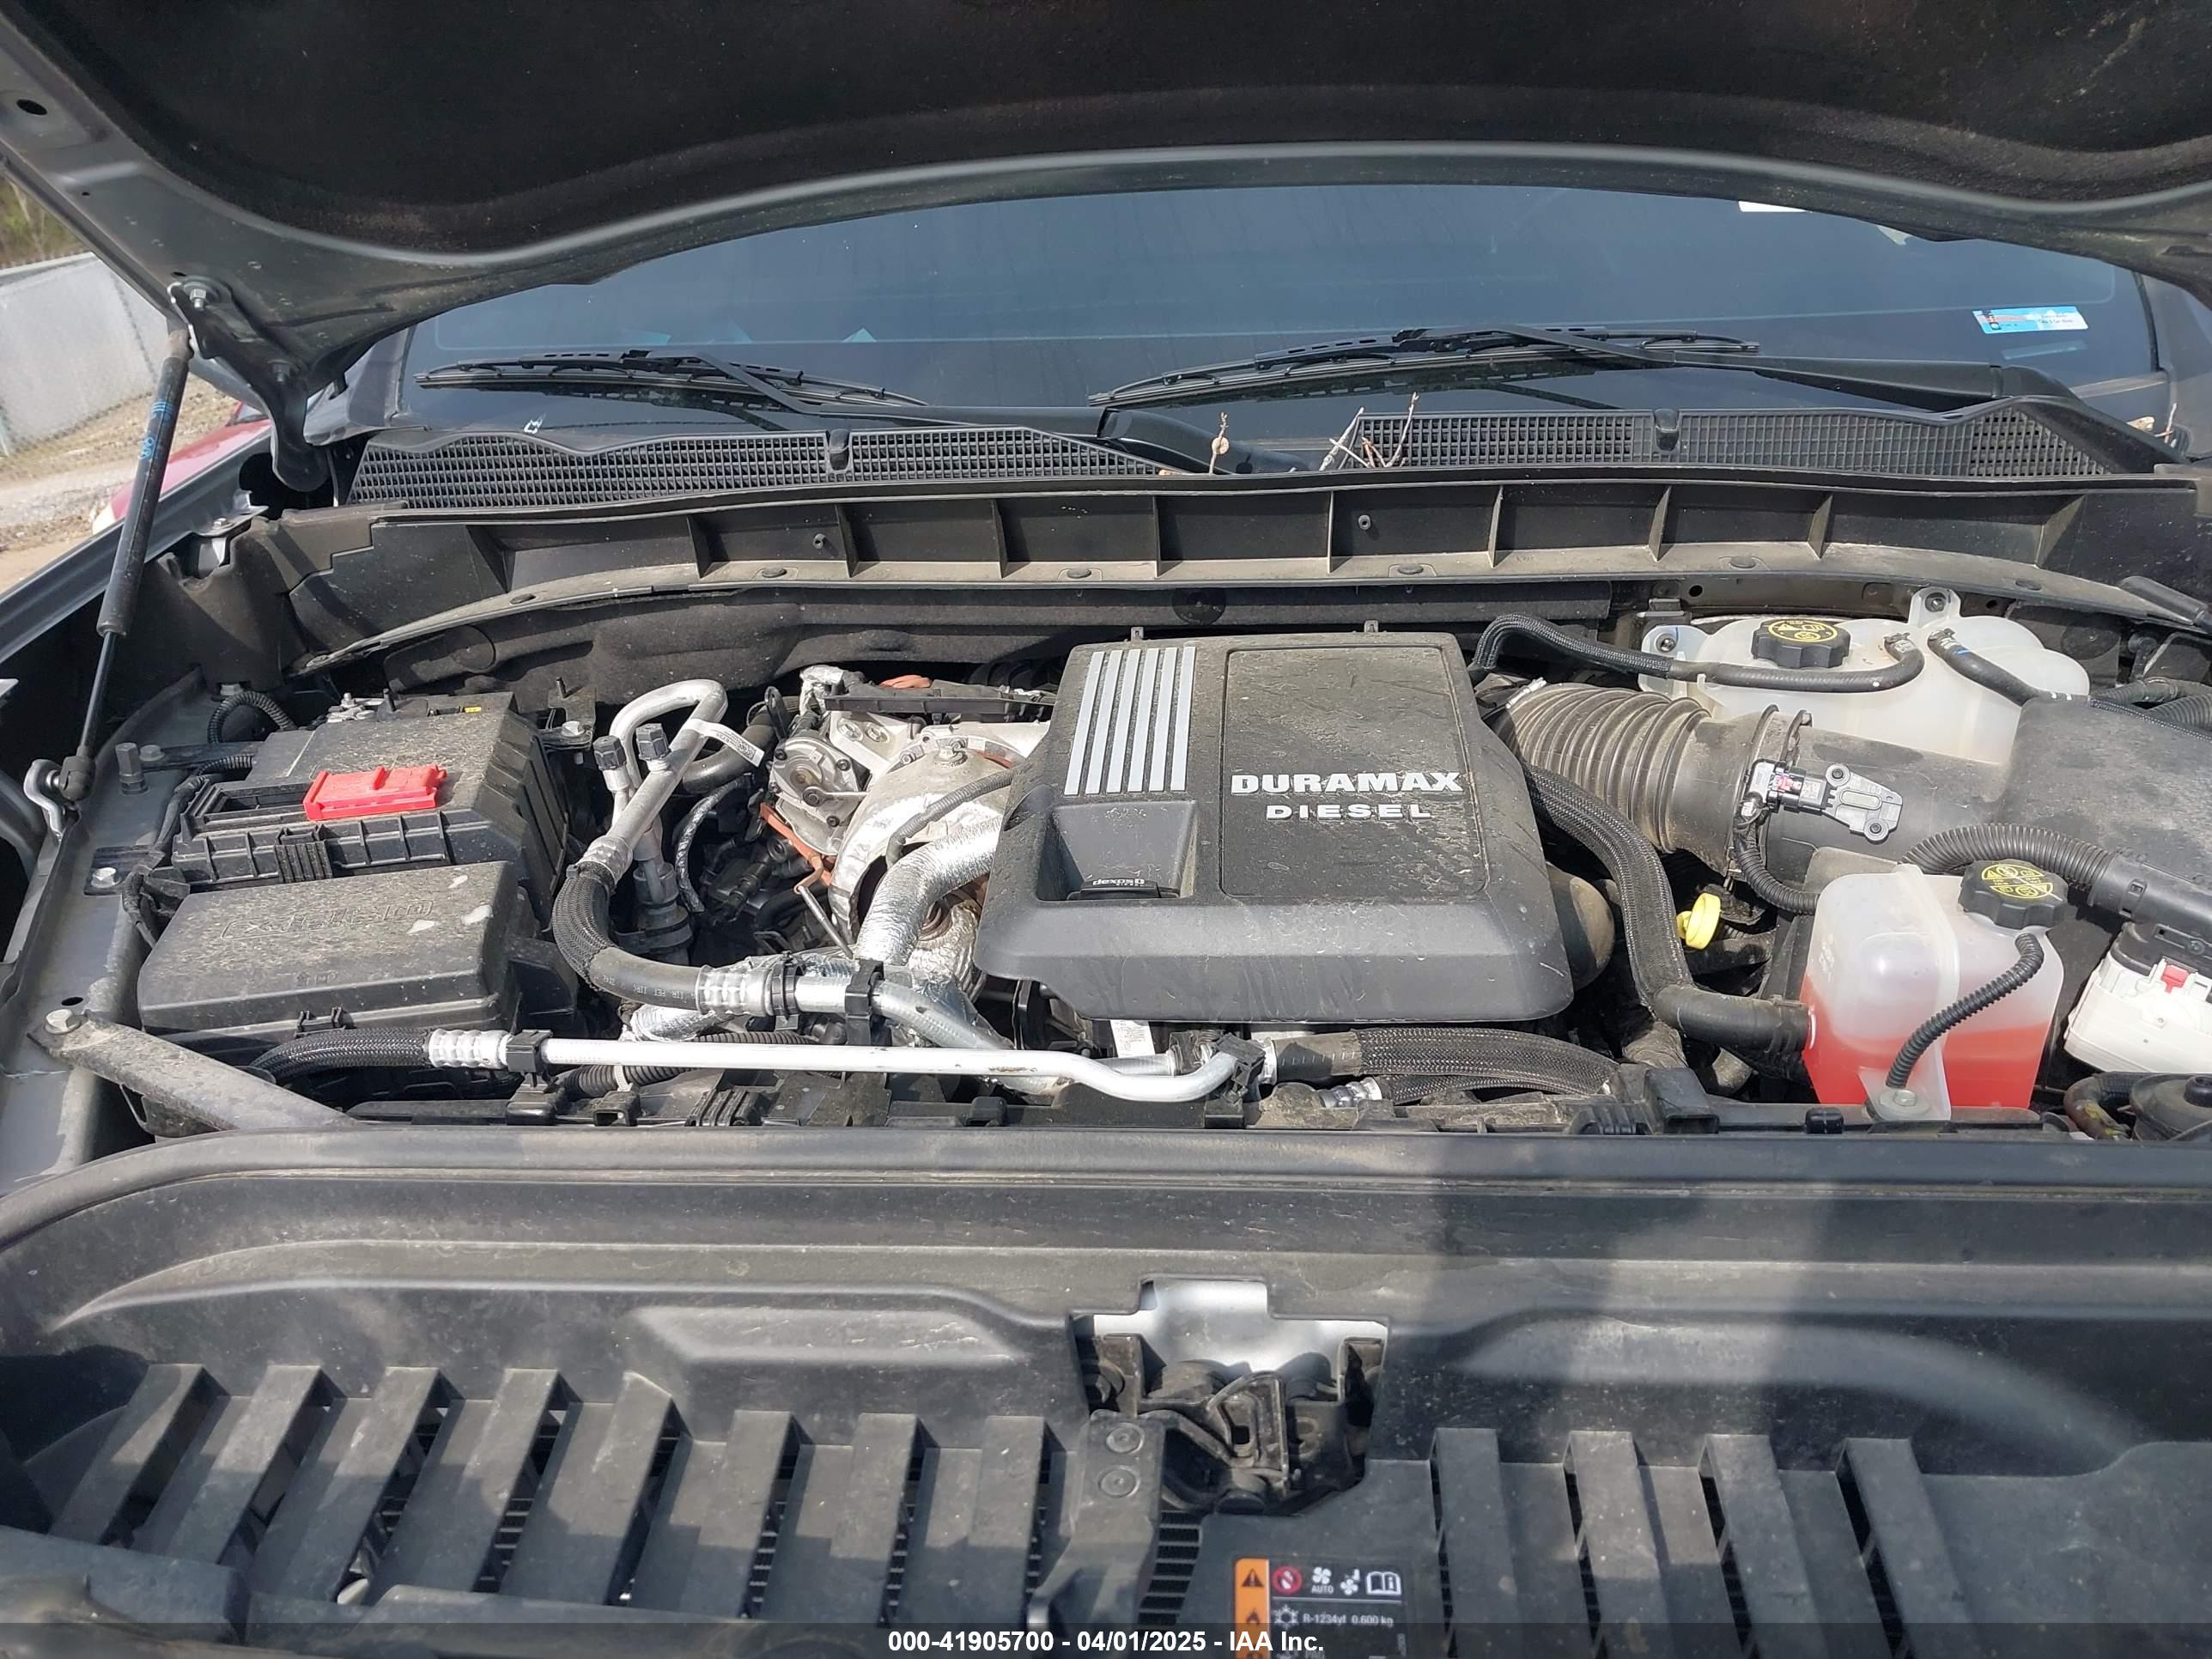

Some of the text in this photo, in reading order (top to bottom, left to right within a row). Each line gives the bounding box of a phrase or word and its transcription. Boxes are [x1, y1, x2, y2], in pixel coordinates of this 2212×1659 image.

[1231, 772, 1464, 794] DURAMAX
[1266, 804, 1431, 821] DIESEL
[1311, 1585, 1334, 1595] AUTO
[1303, 1613, 1394, 1628] R-1234yf 0.600 kg
